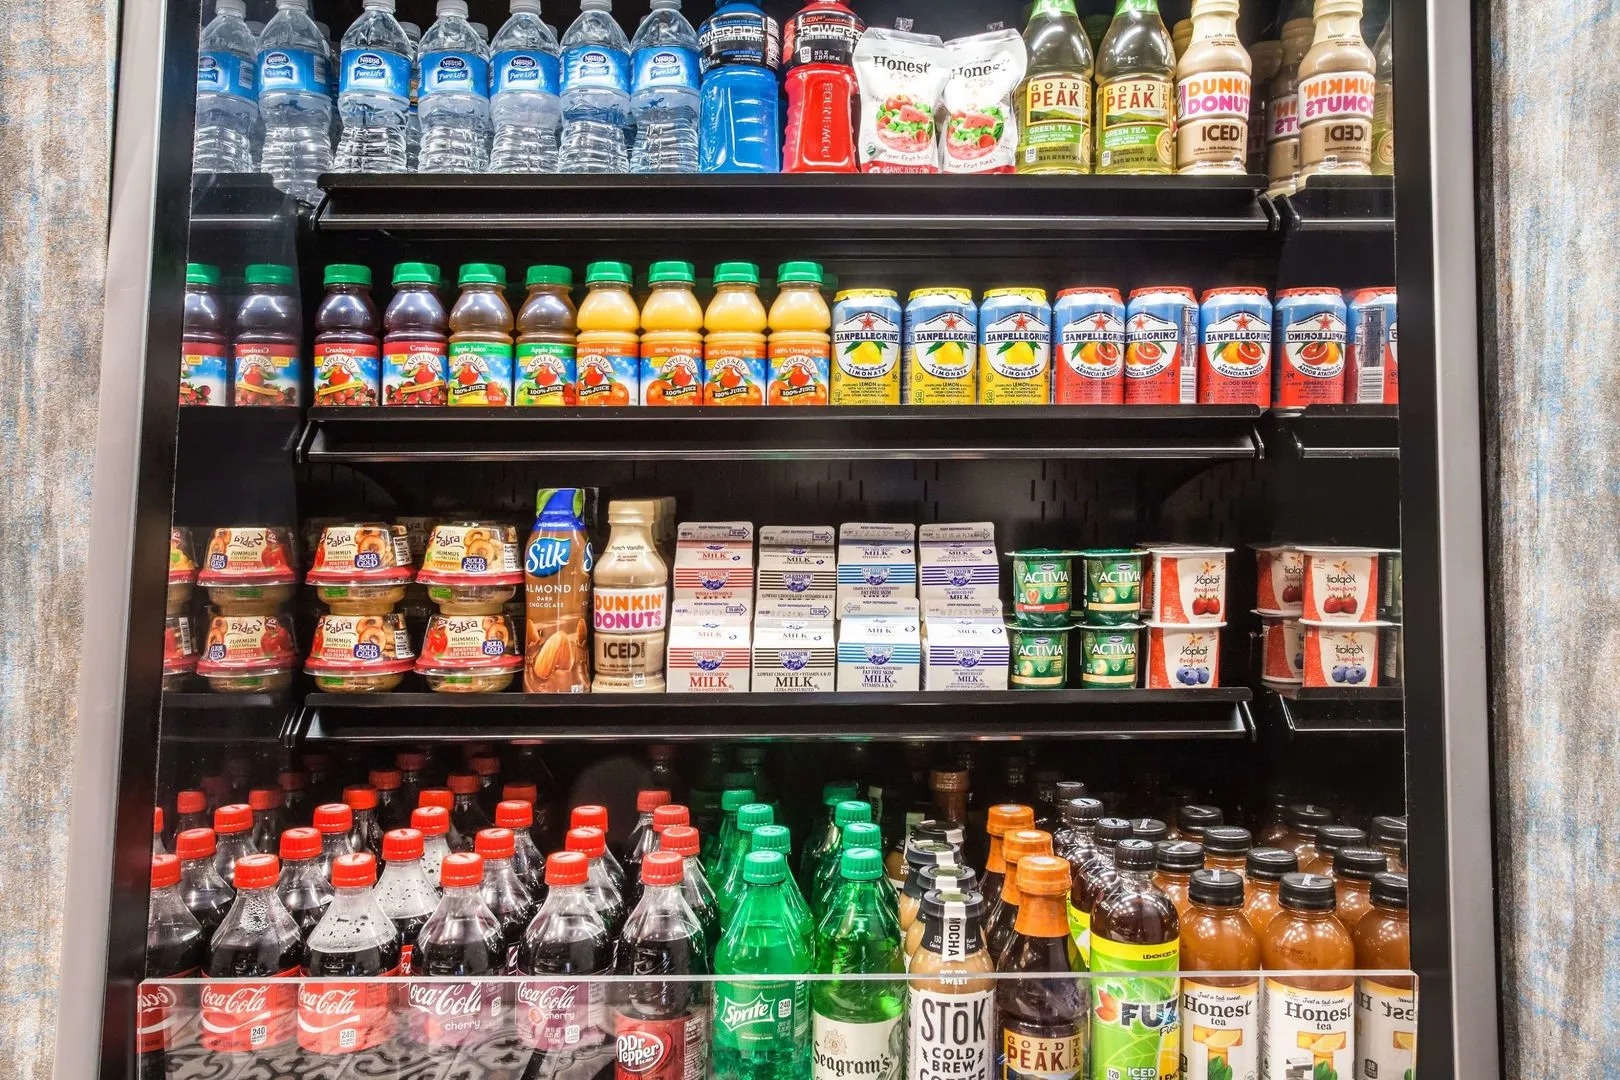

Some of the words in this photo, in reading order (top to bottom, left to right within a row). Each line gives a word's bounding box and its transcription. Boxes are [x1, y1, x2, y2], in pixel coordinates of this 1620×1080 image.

[873, 56, 931, 73] Honest
[355, 70, 369, 78] Pure
[439, 72, 453, 80] Pure
[581, 68, 594, 76] Pure
[595, 67, 608, 75] Life
[651, 69, 663, 77] Pure
[664, 67, 679, 75] Life
[1031, 81, 1080, 91] GOLD
[1106, 83, 1155, 95] GOLD
[1030, 90, 1079, 108] PEAK
[1106, 92, 1155, 113] PEAK
[1187, 95, 1250, 115] DONUT
[1030, 125, 1055, 133] GREEN
[1105, 128, 1129, 137] GREEN
[1131, 126, 1146, 134] TEA
[1201, 125, 1240, 142] ICED
[836, 331, 899, 341] SANPELLEGRINO
[324, 346, 357, 354] Cranberry
[410, 345, 441, 353] Cranberry
[455, 346, 469, 354] Apple
[531, 346, 547, 355] Apple
[548, 346, 564, 354] Juice
[848, 368, 887, 377] LIMONATA
[931, 368, 968, 377] LIMONATA
[1001, 368, 1039, 377] LIMONATA
[1075, 366, 1106, 377] ARANCIATA
[1145, 364, 1164, 376] ROSSA
[1217, 366, 1249, 377] ARANCIATA
[1249, 364, 1264, 376] ROSSA
[455, 387, 467, 395] 100%
[468, 384, 486, 392] JUICE
[326, 532, 352, 548] Sabra
[436, 531, 460, 547] Sabra
[526, 539, 570, 574] Silk
[356, 559, 378, 569] GOLD
[463, 563, 486, 572] GOLD
[1024, 571, 1069, 583] ACTIVIA
[1099, 571, 1141, 583] ACTIVIA
[1194, 575, 1220, 587] Yoplait
[526, 584, 572, 594] ALMOND
[595, 594, 664, 610] DUNKIN'
[595, 611, 662, 629] DONUTS
[325, 619, 352, 634] Sabra
[448, 620, 479, 634] Sabra
[355, 650, 378, 659] GOLD
[485, 646, 504, 655] GOLD
[603, 642, 641, 659] ICED
[1017, 645, 1063, 656] ACTIVIA
[1091, 643, 1137, 655] ACTIVIA
[1180, 645, 1208, 658] Yoplait
[690, 676, 728, 688] MILK
[775, 677, 813, 688] MILK
[864, 675, 892, 683] MILK
[934, 936, 942, 944] 130
[948, 917, 960, 956] MOCHA
[940, 976, 968, 985] SWEET
[201, 985, 270, 1014] Coca-Cola
[780, 1000, 791, 1009] 240
[1184, 993, 1252, 1018] Honest
[1285, 1000, 1353, 1022] Honest
[545, 1011, 575, 1020] cherry
[725, 1002, 769, 1025] Sprite
[1121, 1000, 1178, 1028] FUZ
[445, 1020, 481, 1031] cherry
[1210, 1017, 1227, 1026] tea
[1316, 1022, 1332, 1030] tea
[252, 1026, 266, 1036] 240
[341, 1030, 355, 1039] 240
[1007, 1036, 1065, 1051] GOLD
[813, 1040, 890, 1077] Seagram's
[932, 1047, 975, 1060] COLD
[1007, 1044, 1065, 1071] PEAK
[1072, 1038, 1080, 1068] TEA
[932, 1060, 975, 1073] BREW
[1127, 1066, 1157, 1076] ICED
